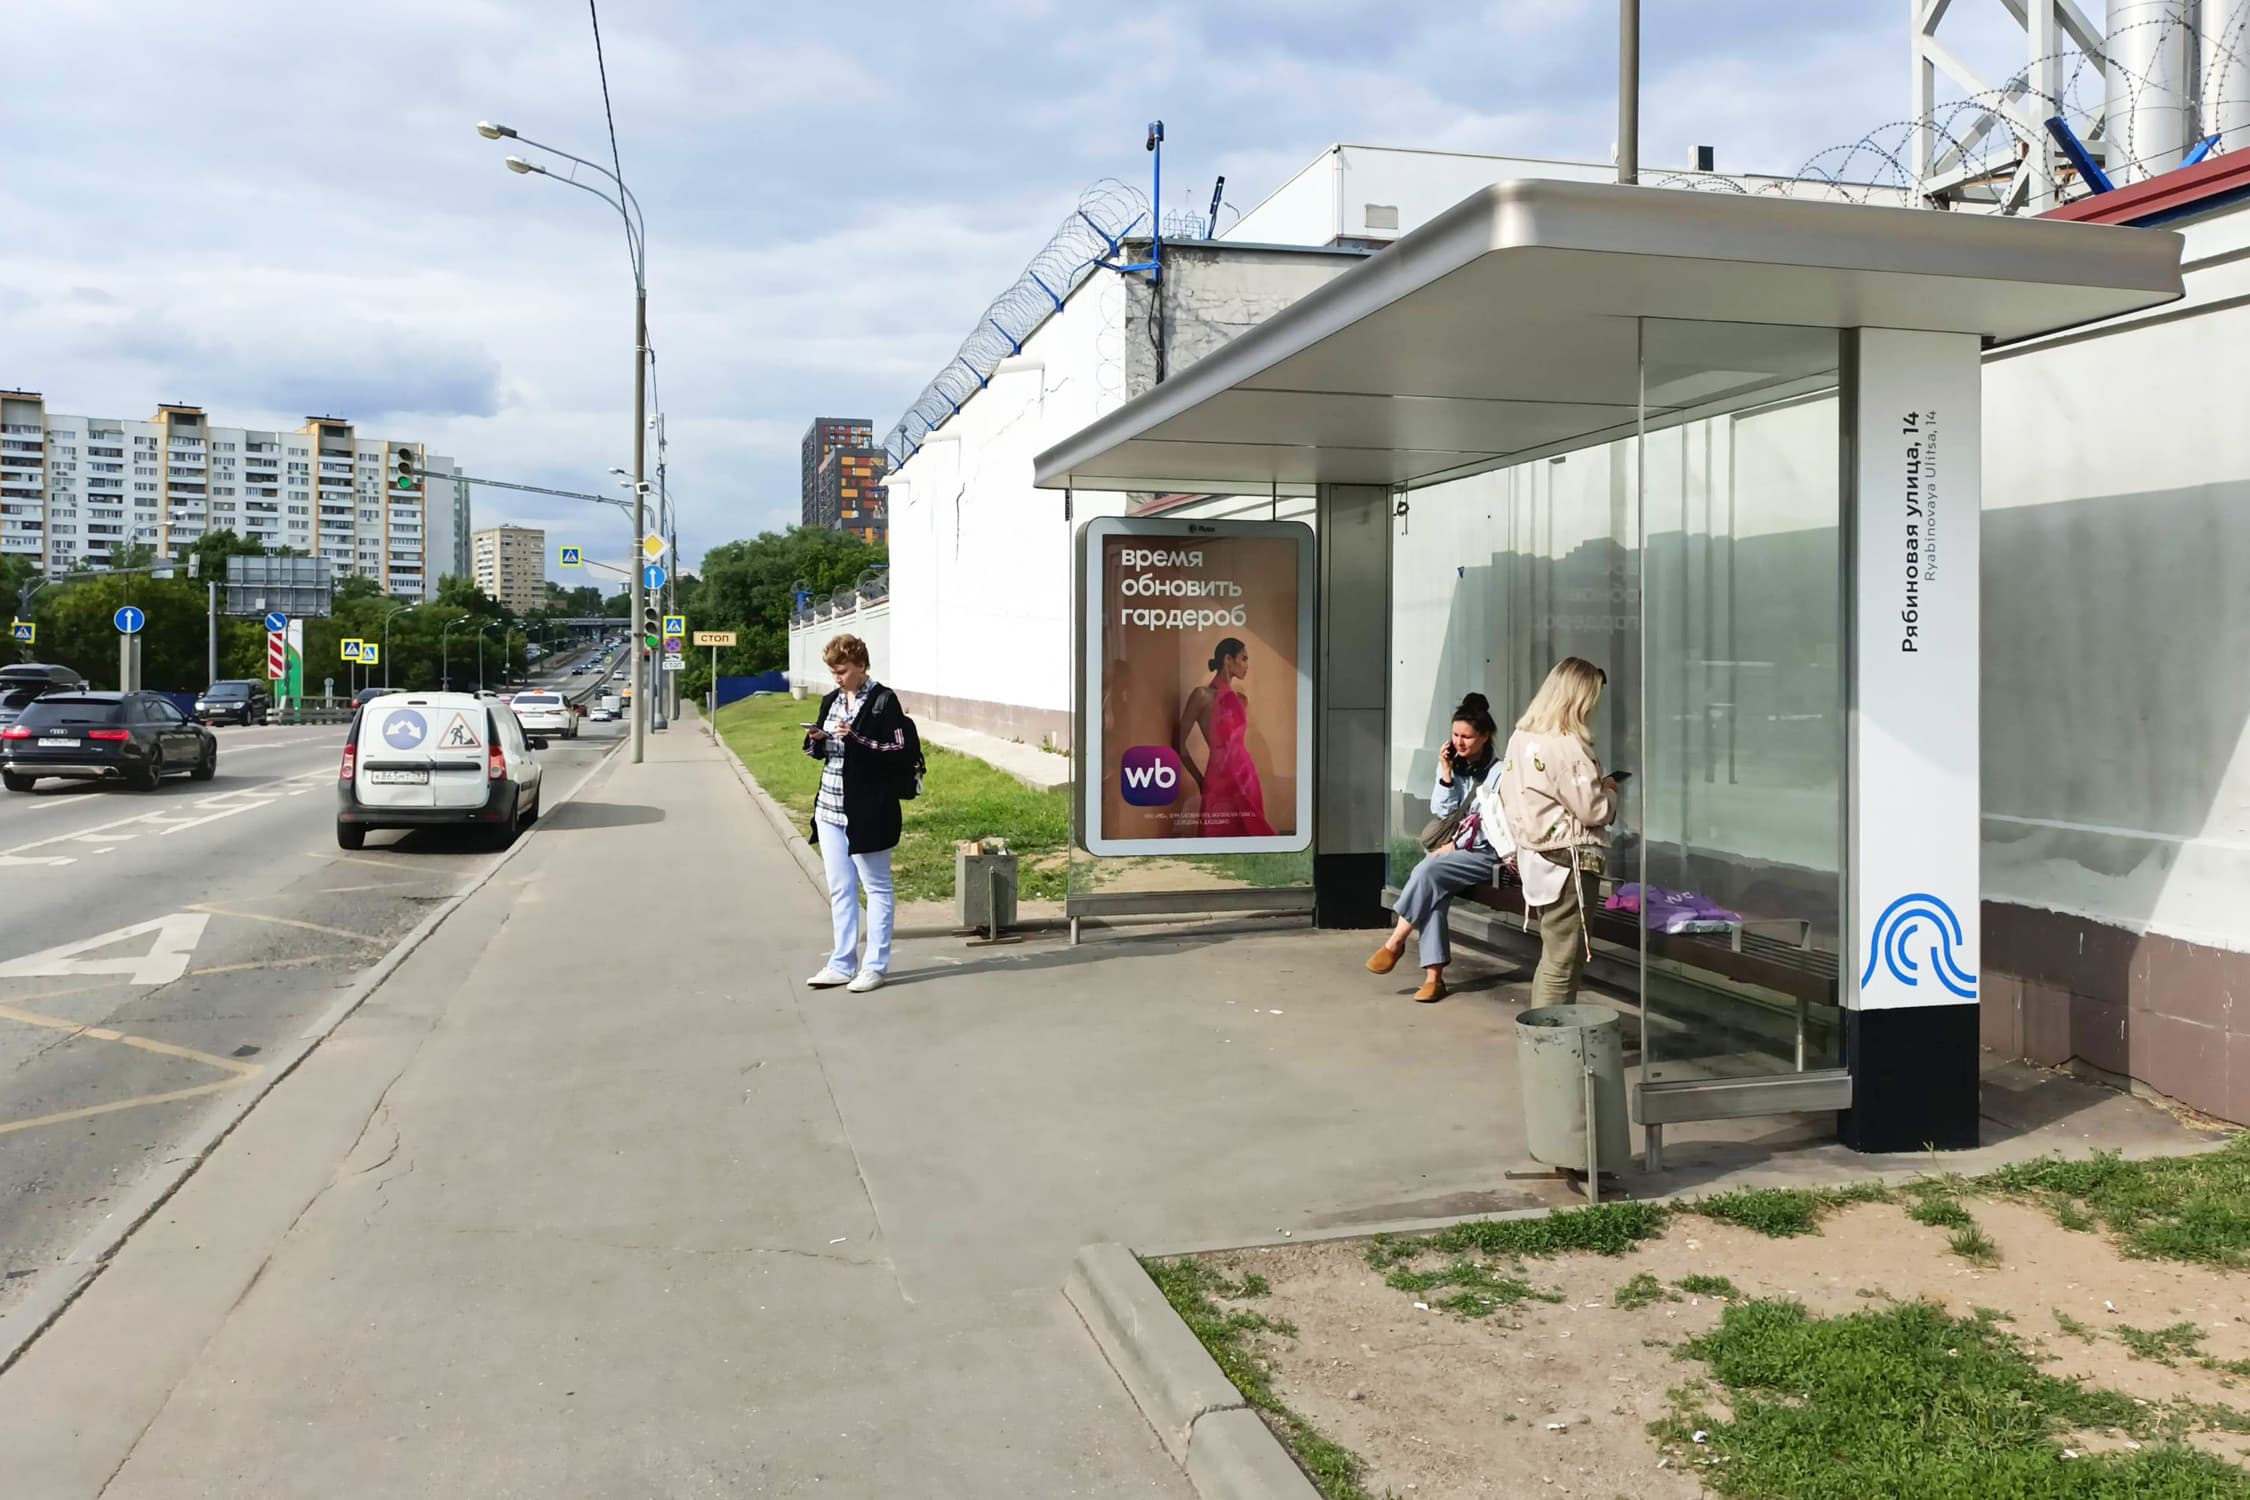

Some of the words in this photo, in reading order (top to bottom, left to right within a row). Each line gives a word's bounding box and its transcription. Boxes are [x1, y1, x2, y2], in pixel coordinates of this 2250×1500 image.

[1903, 411, 1920, 435] 14
[1925, 410, 1937, 425] 14
[1924, 429, 1938, 478] Ulitsa,
[1906, 441, 1923, 518] улица,
[1924, 483, 1938, 581] Ryabinovaya
[1121, 549, 1203, 571] время
[1121, 573, 1242, 597] обновить
[1902, 525, 1919, 652] Рябиновая
[1121, 604, 1247, 631] гардероб
[701, 634, 729, 643] СТОП
[1125, 758, 1176, 789] wb
